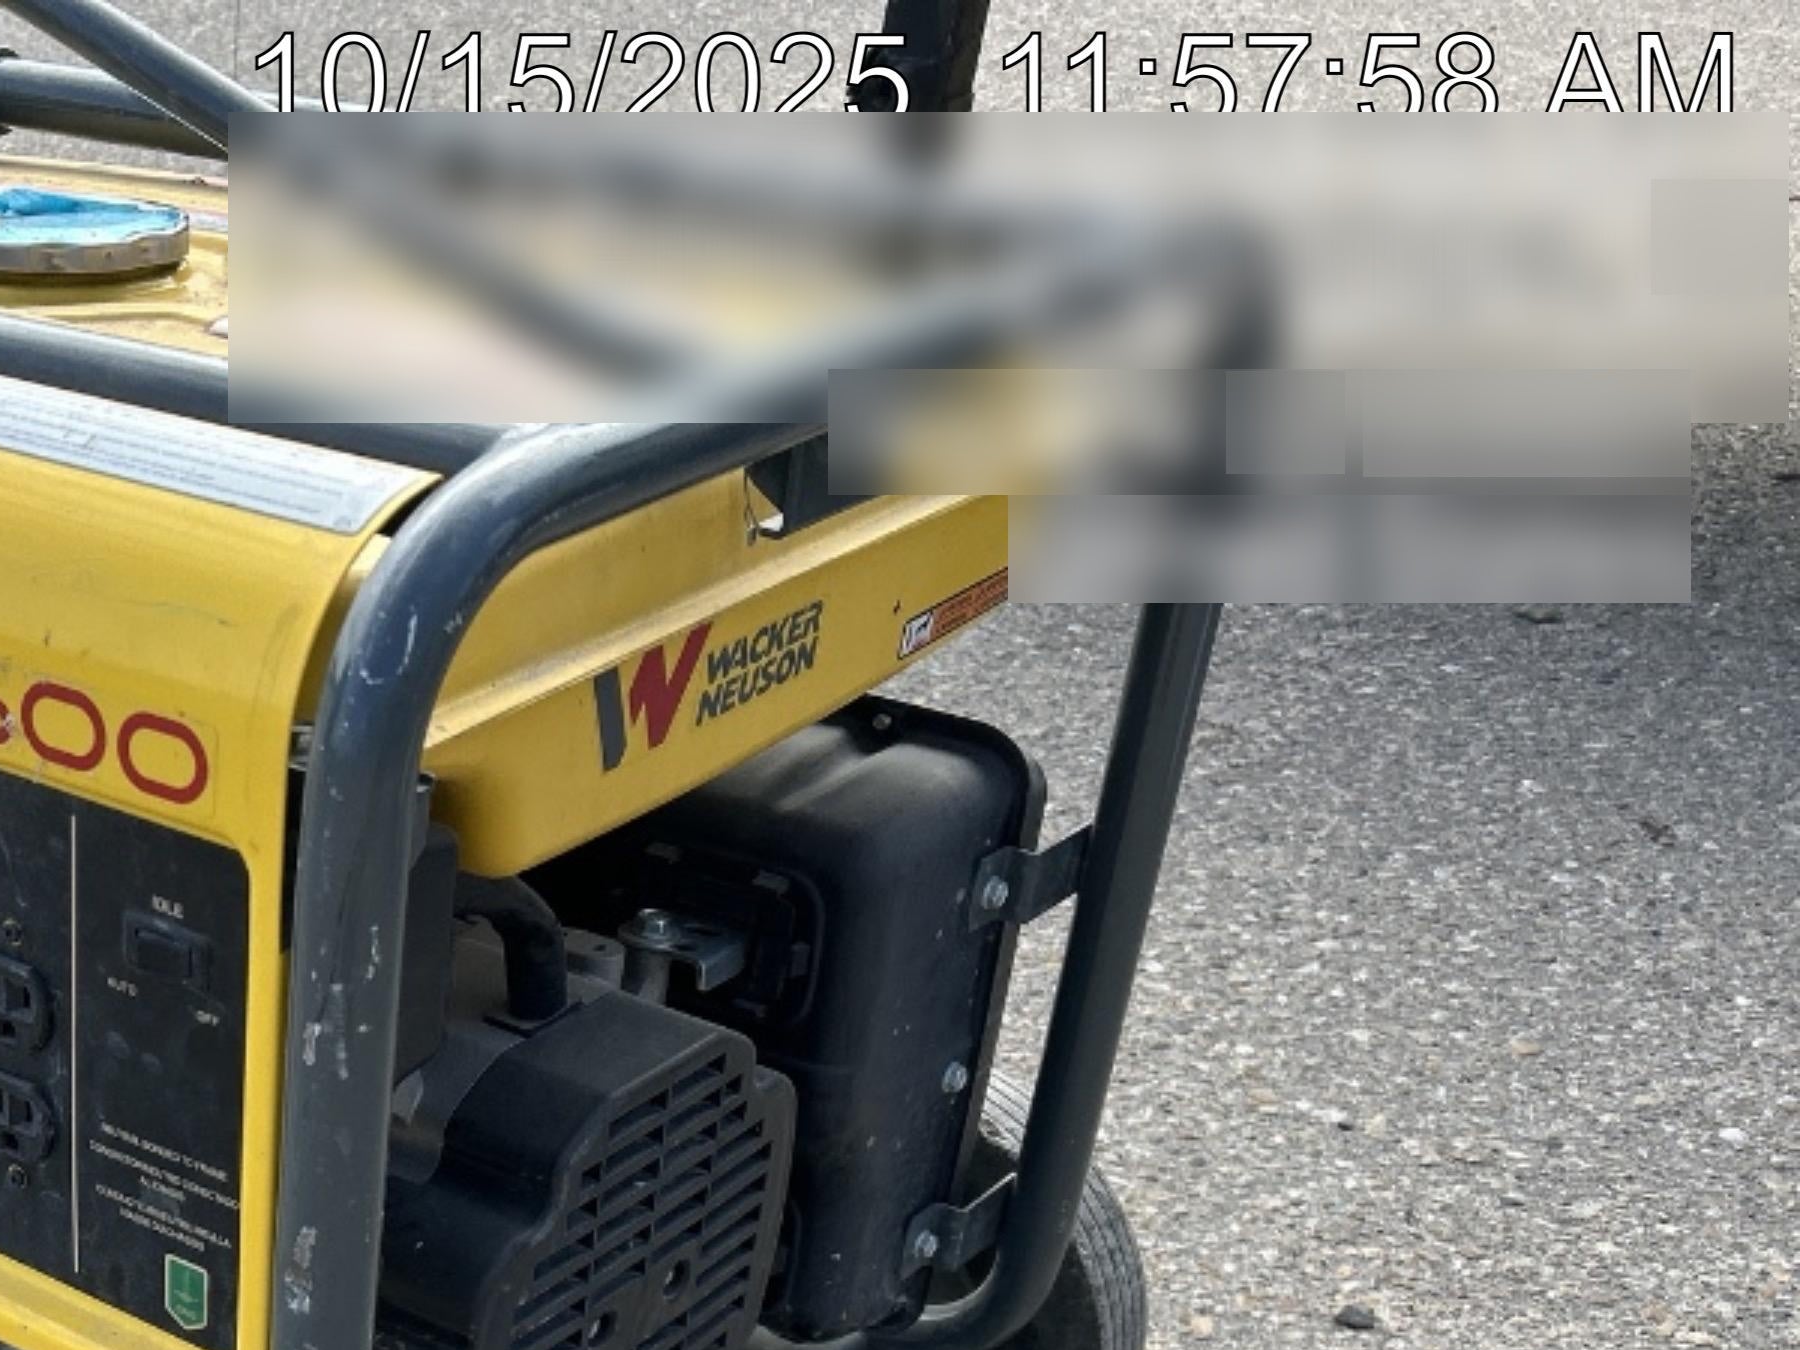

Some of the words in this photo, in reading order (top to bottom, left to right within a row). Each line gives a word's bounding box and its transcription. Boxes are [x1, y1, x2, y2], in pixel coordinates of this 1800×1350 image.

[696, 636, 820, 728] NEUSON
[707, 601, 823, 684] WACKER
[152, 894, 184, 920] IDLE
